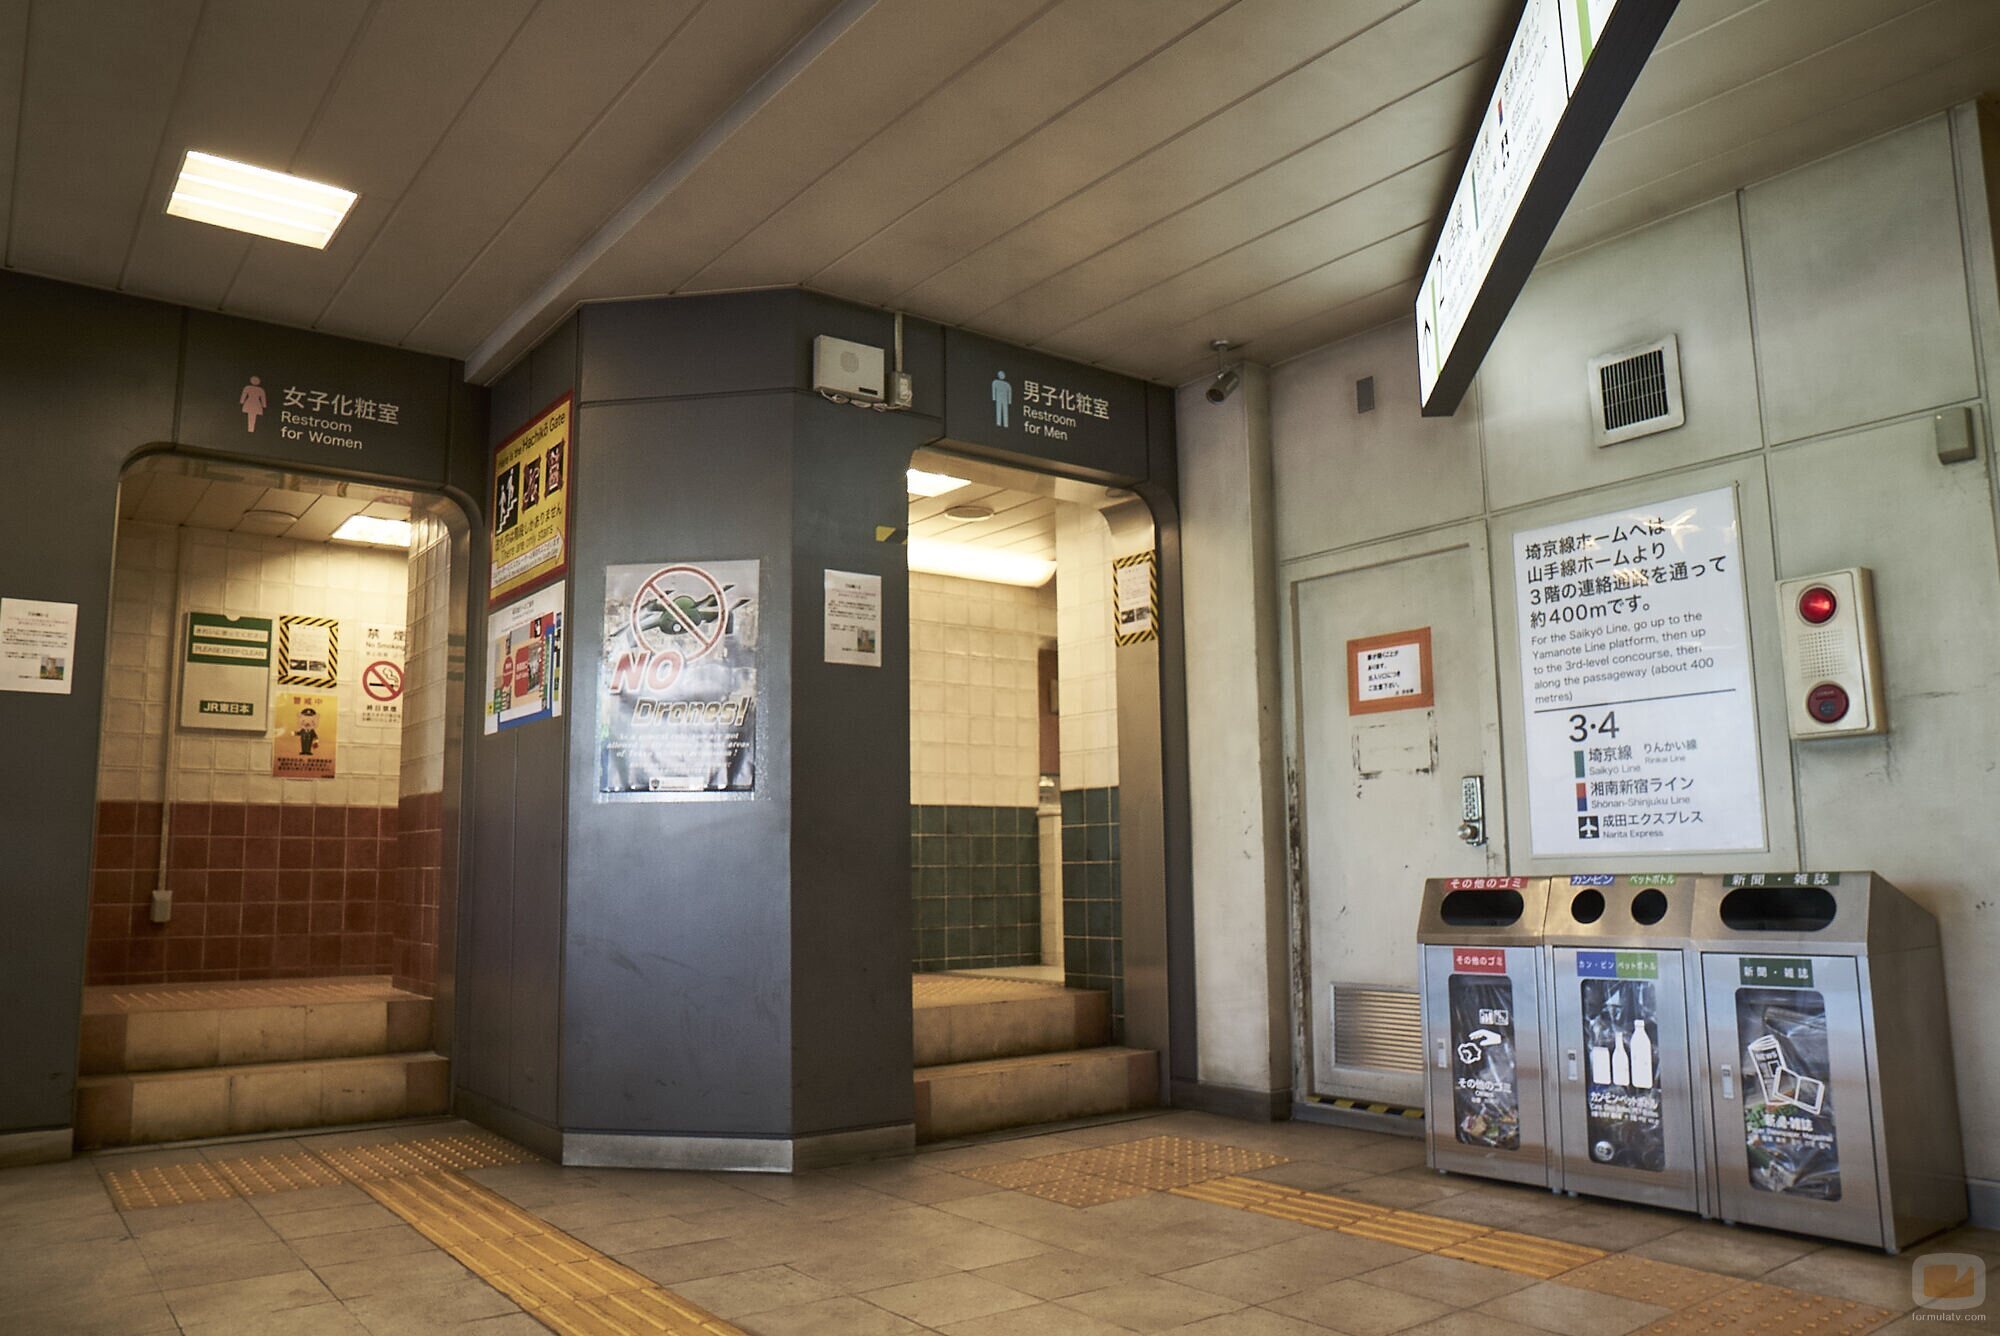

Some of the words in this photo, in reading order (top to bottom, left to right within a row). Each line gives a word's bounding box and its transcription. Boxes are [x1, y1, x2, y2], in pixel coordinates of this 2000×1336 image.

[283, 386, 399, 425] 女子化粧室
[1024, 380, 1110, 420] 男子化粧室
[281, 411, 352, 432] Restroom
[549, 413, 566, 432] Gate
[1023, 405, 1077, 428] Restroom
[280, 426, 304, 440] for
[308, 430, 363, 450] Women
[1023, 421, 1041, 434] for
[1044, 425, 1068, 441] Men
[1525, 517, 1666, 561] 埼京線ホームへは
[1528, 542, 1666, 584] 山手線ホームより
[1530, 555, 1727, 605] 3階の連絡通路を通って
[1530, 594, 1651, 629] 約400mです。
[1531, 636, 1547, 646] For
[1550, 632, 1566, 642] the
[1634, 621, 1648, 631] go
[1651, 618, 1665, 628] up
[1668, 615, 1681, 625] to
[1683, 611, 1703, 623] the
[195, 645, 220, 653] PLEASE
[241, 649, 265, 657] CLEAN
[1532, 645, 1582, 660] Yamanote
[1584, 642, 1606, 653] Line
[1662, 629, 1688, 641] then
[1691, 628, 1706, 638] up
[610, 650, 683, 693] NO
[1533, 666, 1544, 675] to
[1546, 663, 1562, 673] the
[1565, 656, 1610, 670] 3rd-level
[1612, 649, 1673, 664] concourse,
[1534, 678, 1561, 690] along
[1564, 674, 1580, 685] the
[1583, 667, 1647, 684] passageway
[1651, 661, 1688, 676] (about
[1691, 657, 1714, 669] 400
[203, 702, 250, 714] JR東日本
[1535, 691, 1573, 704] metres)
[632, 696, 751, 726] Drones!
[1588, 744, 1633, 763] 埼京線
[1643, 739, 1697, 753] りんかい線
[1645, 756, 1668, 764] Rinkai
[1622, 765, 1641, 774] Line
[1590, 777, 1694, 797] 湘南新宿ライン
[1671, 796, 1691, 805] Line
[1603, 810, 1704, 827] 成田エクスプレス
[1603, 830, 1628, 838] Narita
[1630, 829, 1664, 838] Express
[1450, 878, 1521, 889] その他のゴミ
[1456, 955, 1503, 966] その他のゴミ
[1458, 1077, 1512, 1093] その他のゴミ
